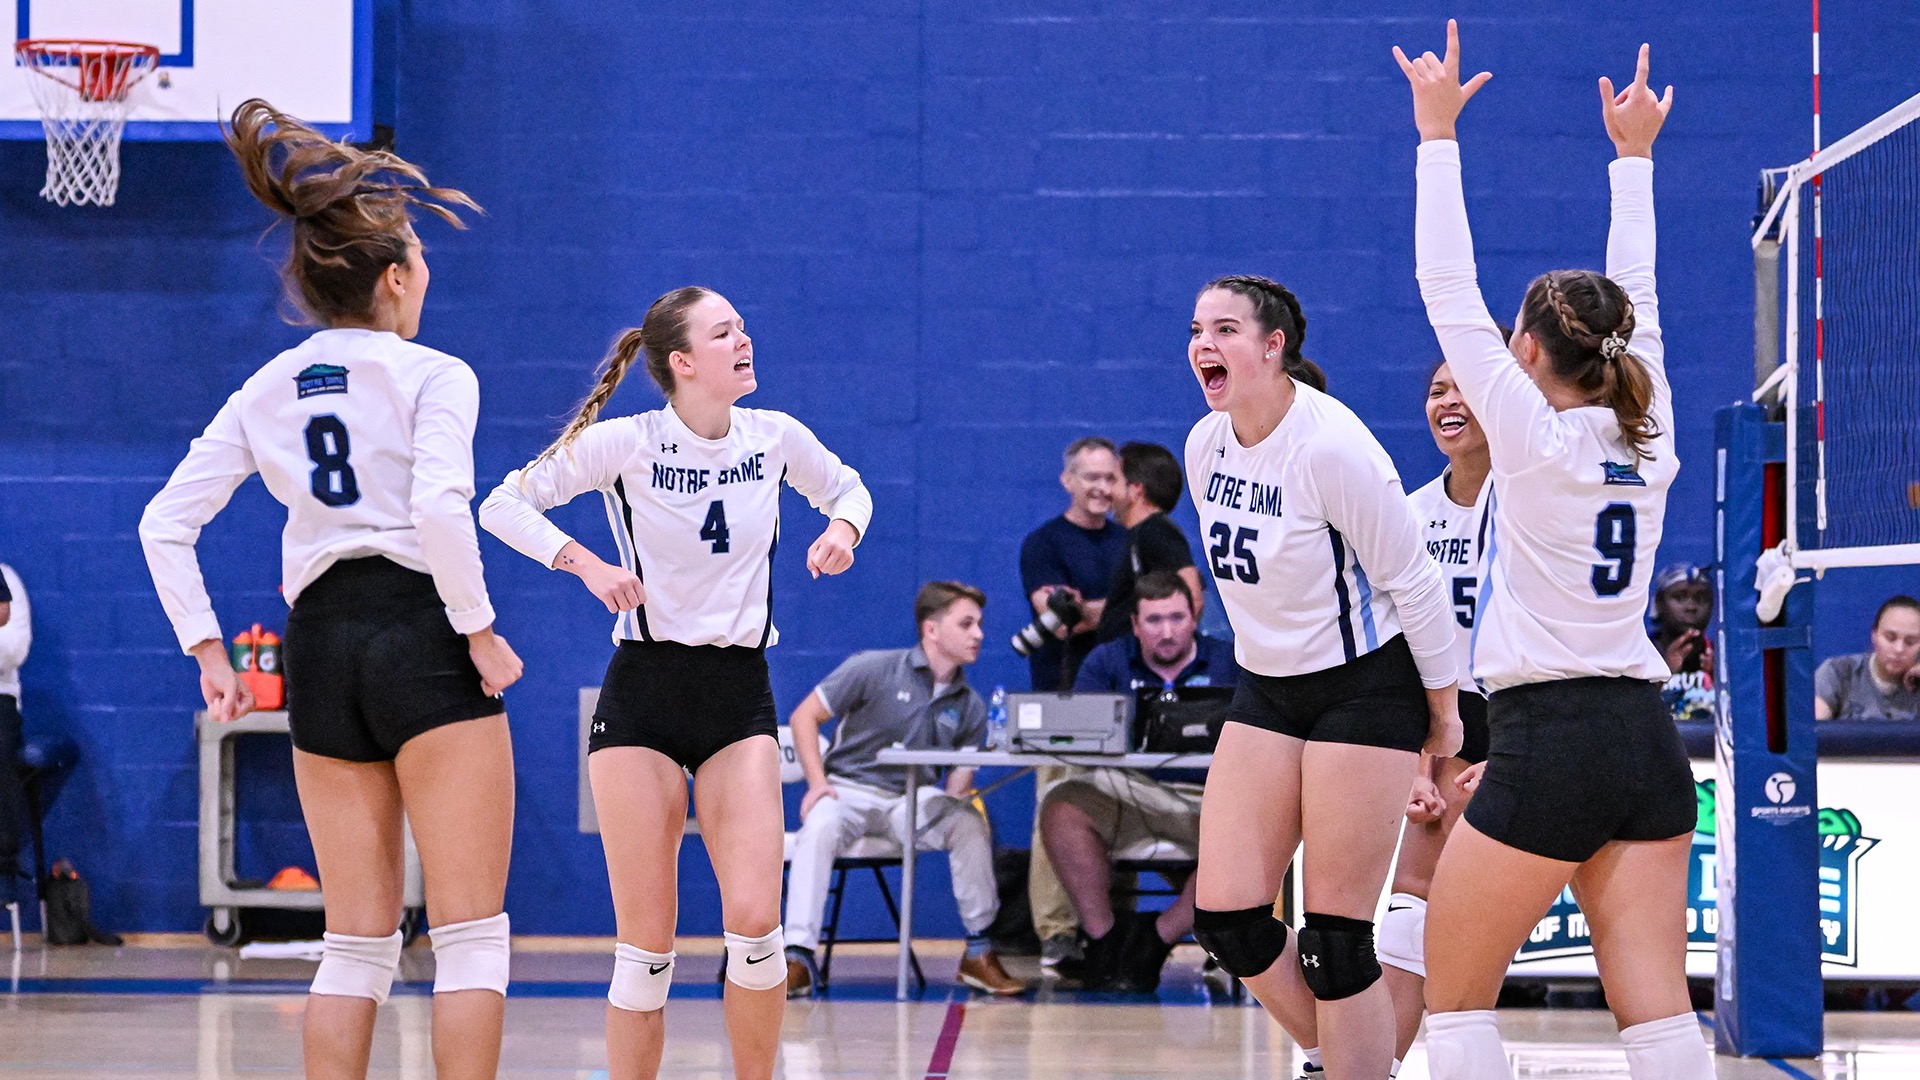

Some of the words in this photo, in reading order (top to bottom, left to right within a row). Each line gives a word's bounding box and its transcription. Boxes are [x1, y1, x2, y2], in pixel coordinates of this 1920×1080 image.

[302, 412, 362, 508] 8
[652, 462, 710, 494] NOTRE
[1203, 471, 1247, 510] OTRE
[699, 499, 730, 555] 4
[1209, 521, 1261, 585] 25
[1589, 501, 1637, 598] 9
[1452, 577, 1478, 629] 5
